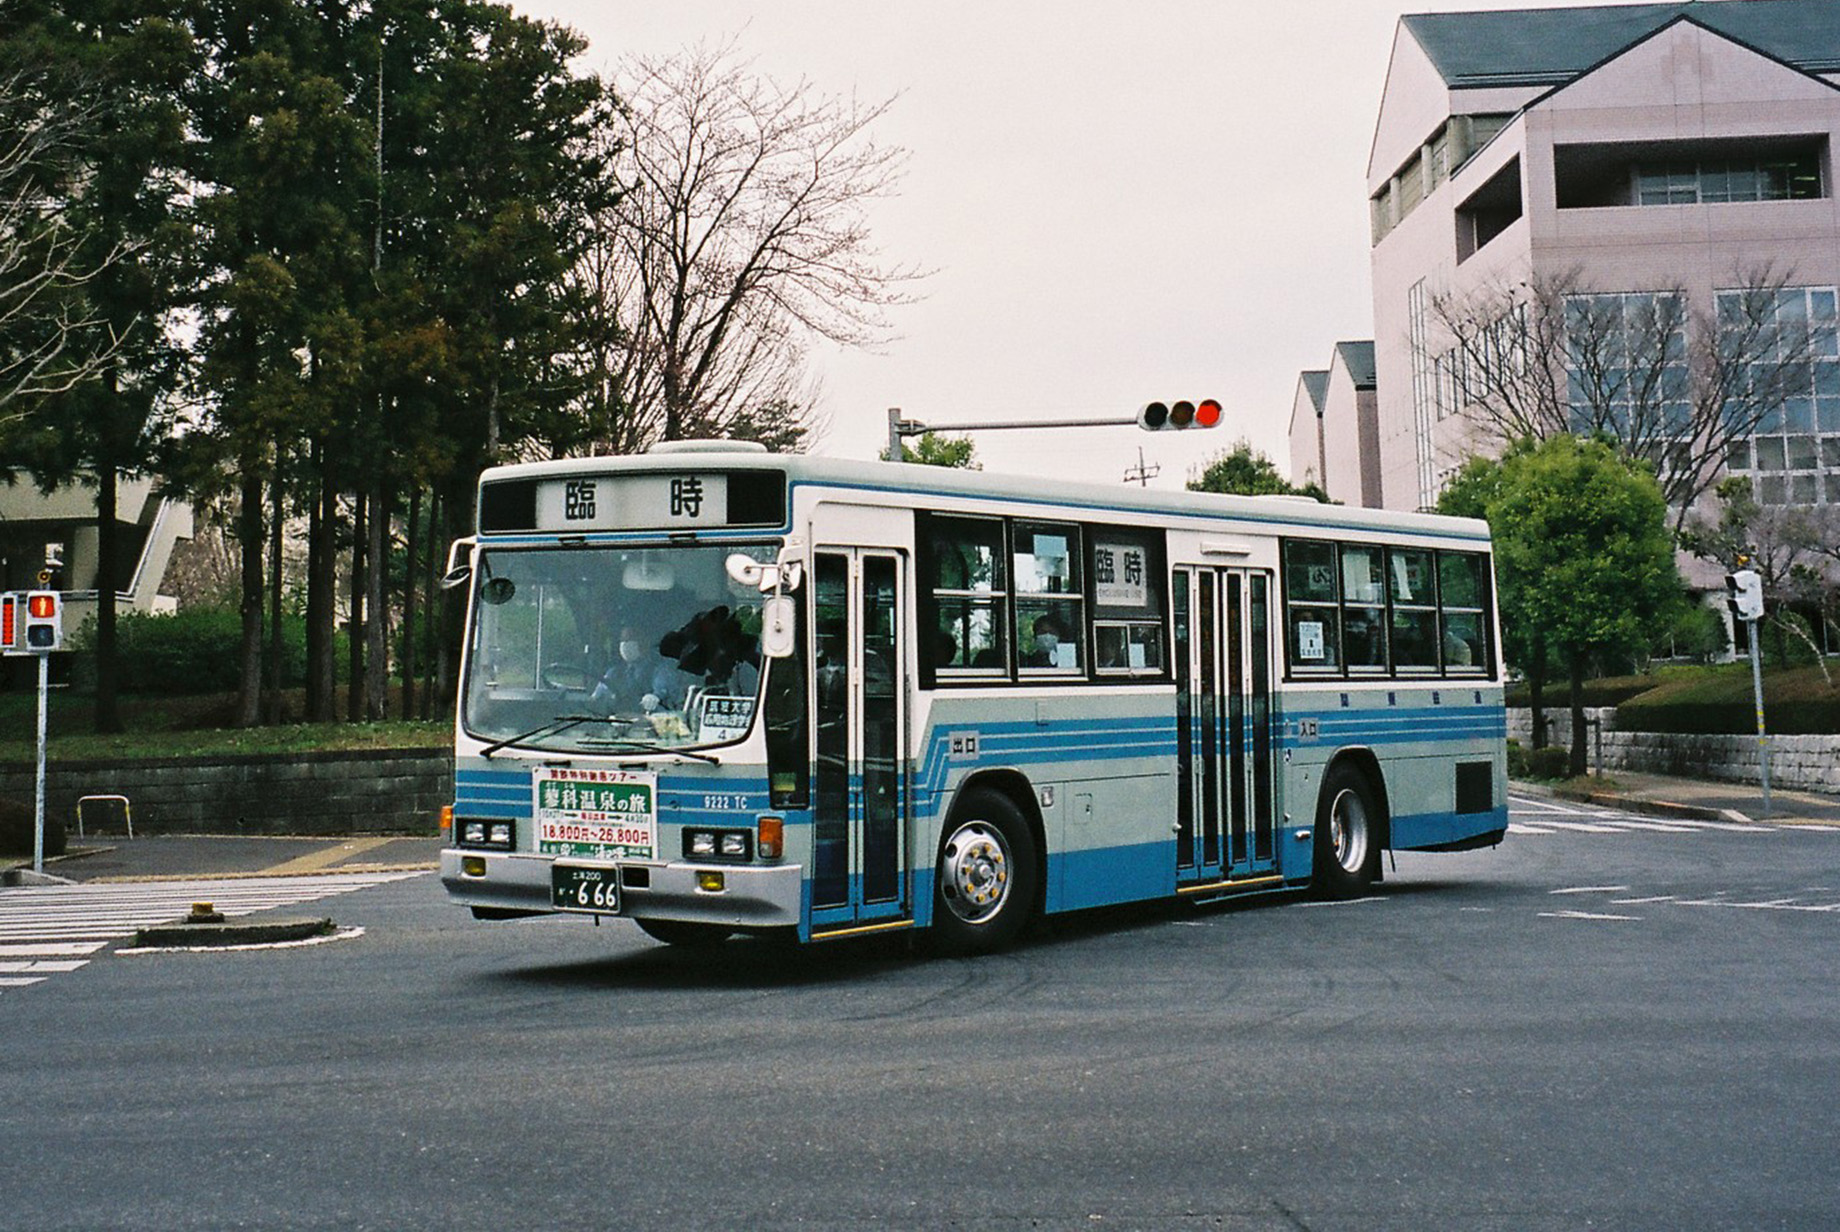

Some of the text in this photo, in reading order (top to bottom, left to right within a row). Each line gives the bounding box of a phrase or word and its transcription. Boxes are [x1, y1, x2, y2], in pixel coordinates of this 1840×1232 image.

[565, 477, 703, 520] 臨時
[1096, 548, 1142, 586] 臨時
[1300, 722, 1316, 736] 入口
[953, 737, 975, 753] 出口
[705, 795, 747, 809] 9222 TC
